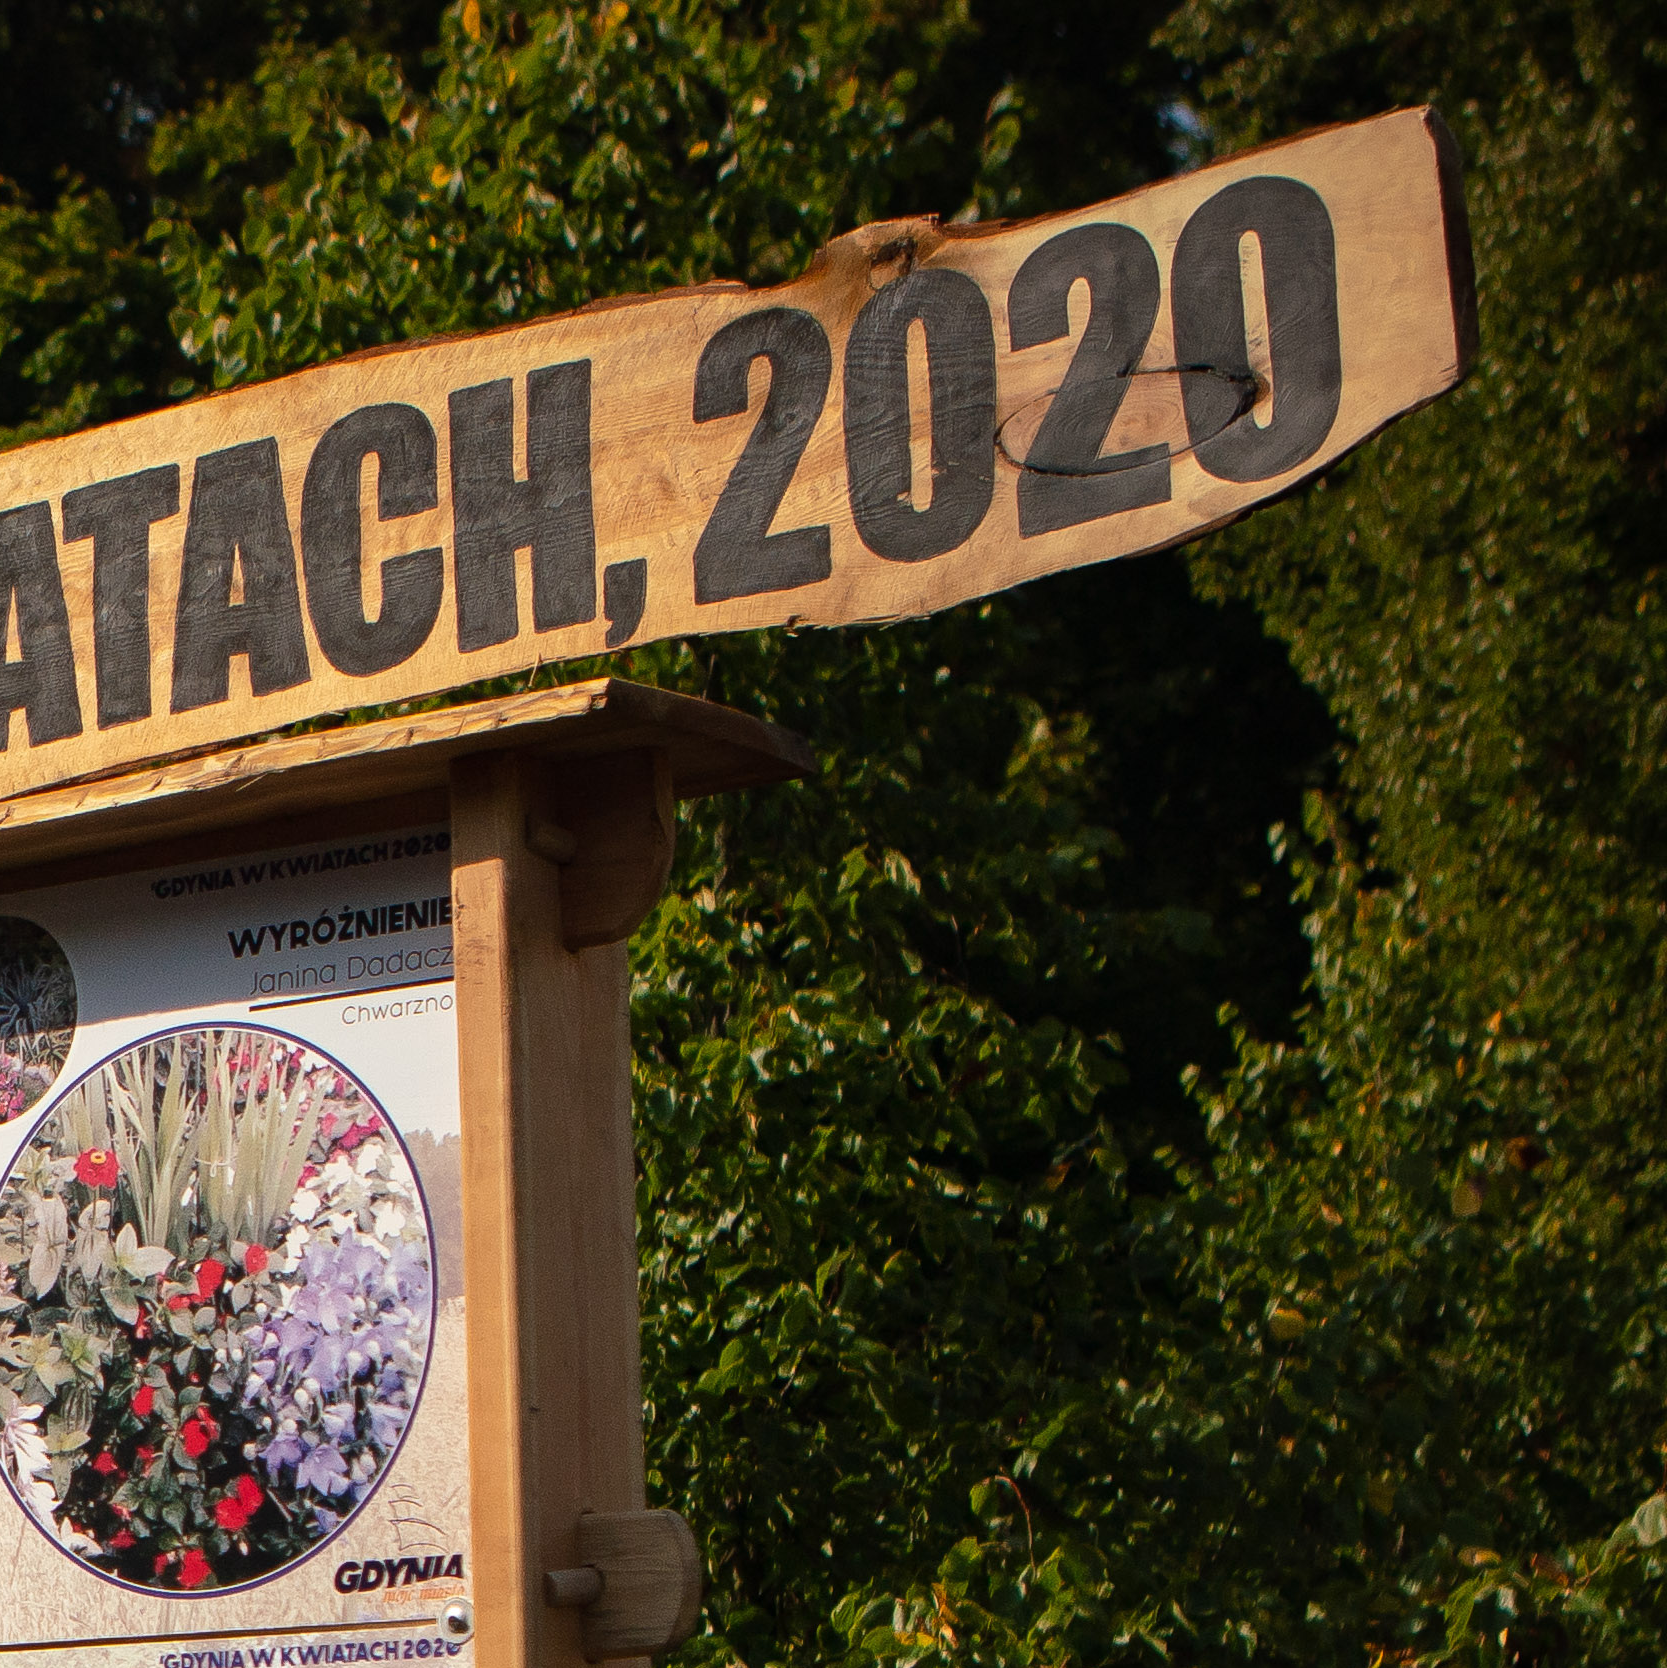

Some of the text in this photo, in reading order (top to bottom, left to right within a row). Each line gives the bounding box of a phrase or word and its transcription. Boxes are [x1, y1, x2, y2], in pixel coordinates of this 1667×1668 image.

[692, 174, 1343, 605] 2020
[238, 861, 267, 884] W
[268, 845, 389, 880] KWIATACH
[228, 896, 453, 958] WYRÓŻNIENIE
[249, 946, 454, 996] Janina Dadacz
[342, 993, 452, 1025] Chwarzno
[334, 1554, 463, 1594] GDYNIA
[252, 1649, 276, 1668] W
[281, 1641, 399, 1666] KWIATACH
